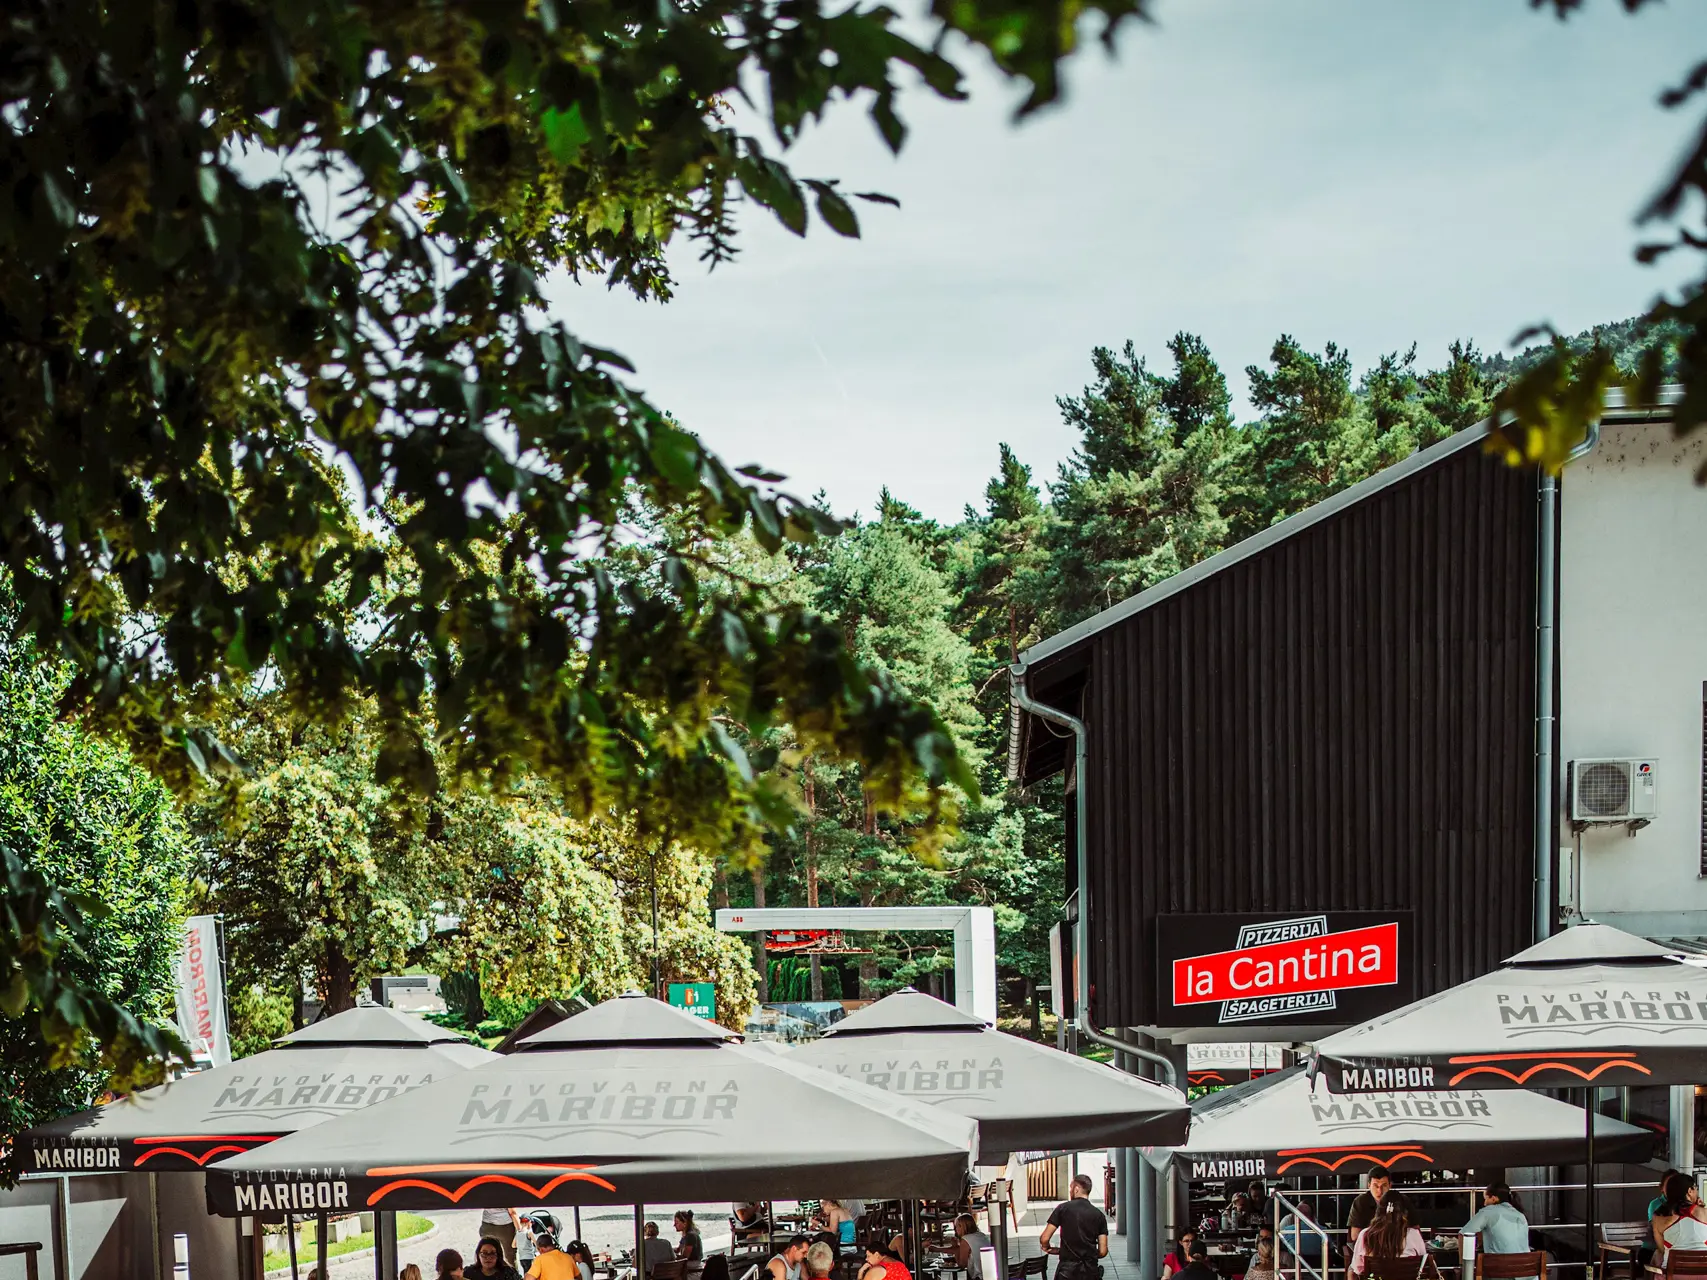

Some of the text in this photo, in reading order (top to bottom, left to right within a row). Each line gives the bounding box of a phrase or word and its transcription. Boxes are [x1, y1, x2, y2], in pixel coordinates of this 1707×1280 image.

[1244, 923, 1320, 947] PIZZERIJA
[1187, 943, 1381, 997] la Cantina
[1228, 993, 1329, 1016] ŠPAGETERIJA
[1497, 990, 1707, 1004] PIVOVARN
[818, 1057, 1004, 1074] VOVARNA
[228, 1073, 433, 1086] PIVOVARNA
[470, 1080, 740, 1097] PIVOVARNA
[844, 1069, 1004, 1090] RIBOR
[1342, 1067, 1434, 1090] MARIBOR
[459, 1094, 739, 1125] MARIBOR
[1311, 1099, 1492, 1122] MARIBOR
[33, 1136, 119, 1147] PIVOVARNA
[34, 1147, 120, 1168] MARIBOR
[232, 1167, 347, 1183] PIVOVARNA
[1193, 1159, 1266, 1178] MARIBOR
[234, 1181, 348, 1212] MARIBOR
